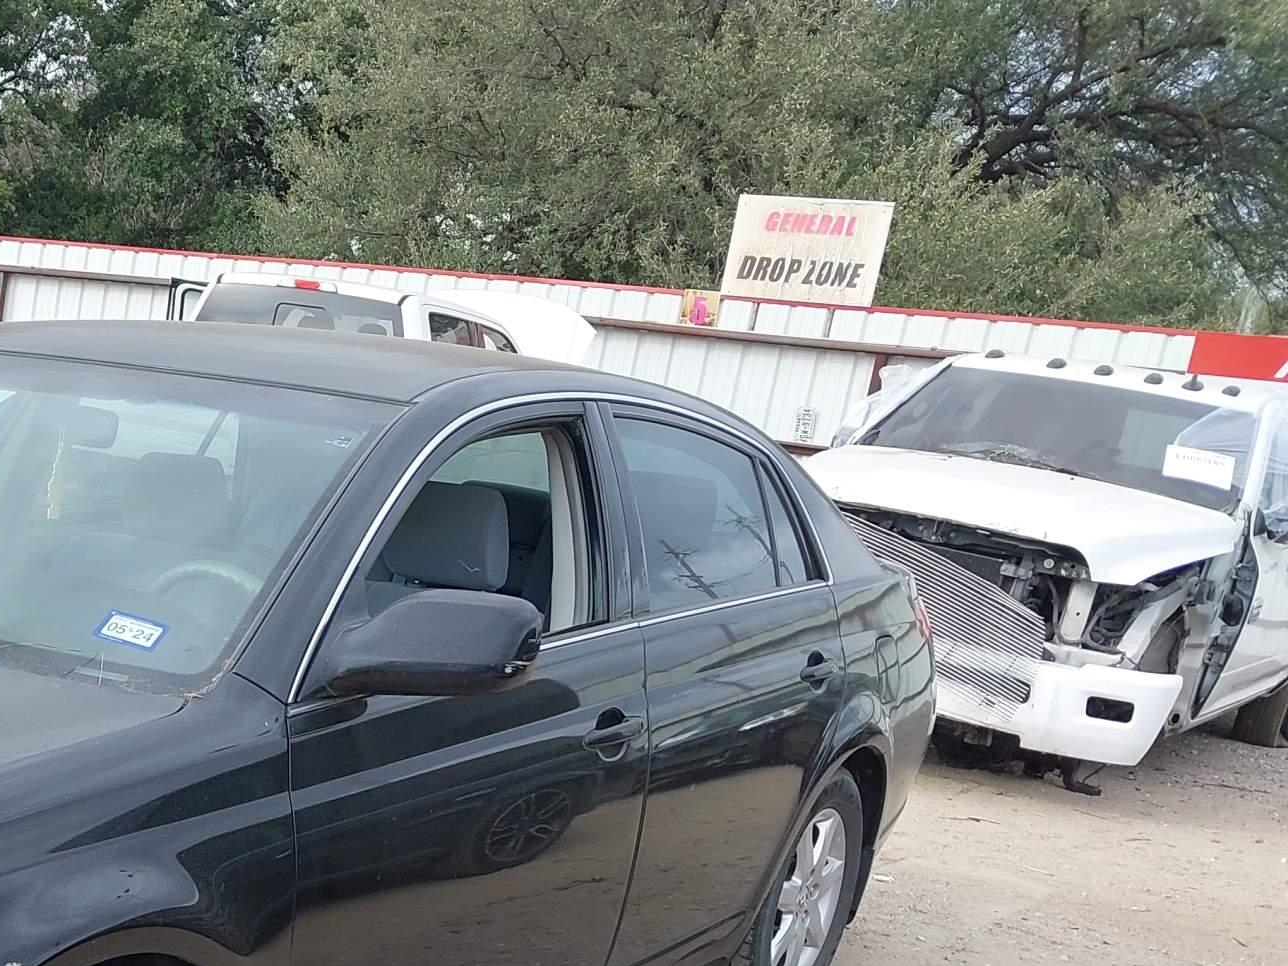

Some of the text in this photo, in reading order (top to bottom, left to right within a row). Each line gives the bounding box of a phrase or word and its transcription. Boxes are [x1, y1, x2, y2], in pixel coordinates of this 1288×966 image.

[765, 211, 857, 236] GENERAL
[737, 255, 865, 288] DROP ZONE
